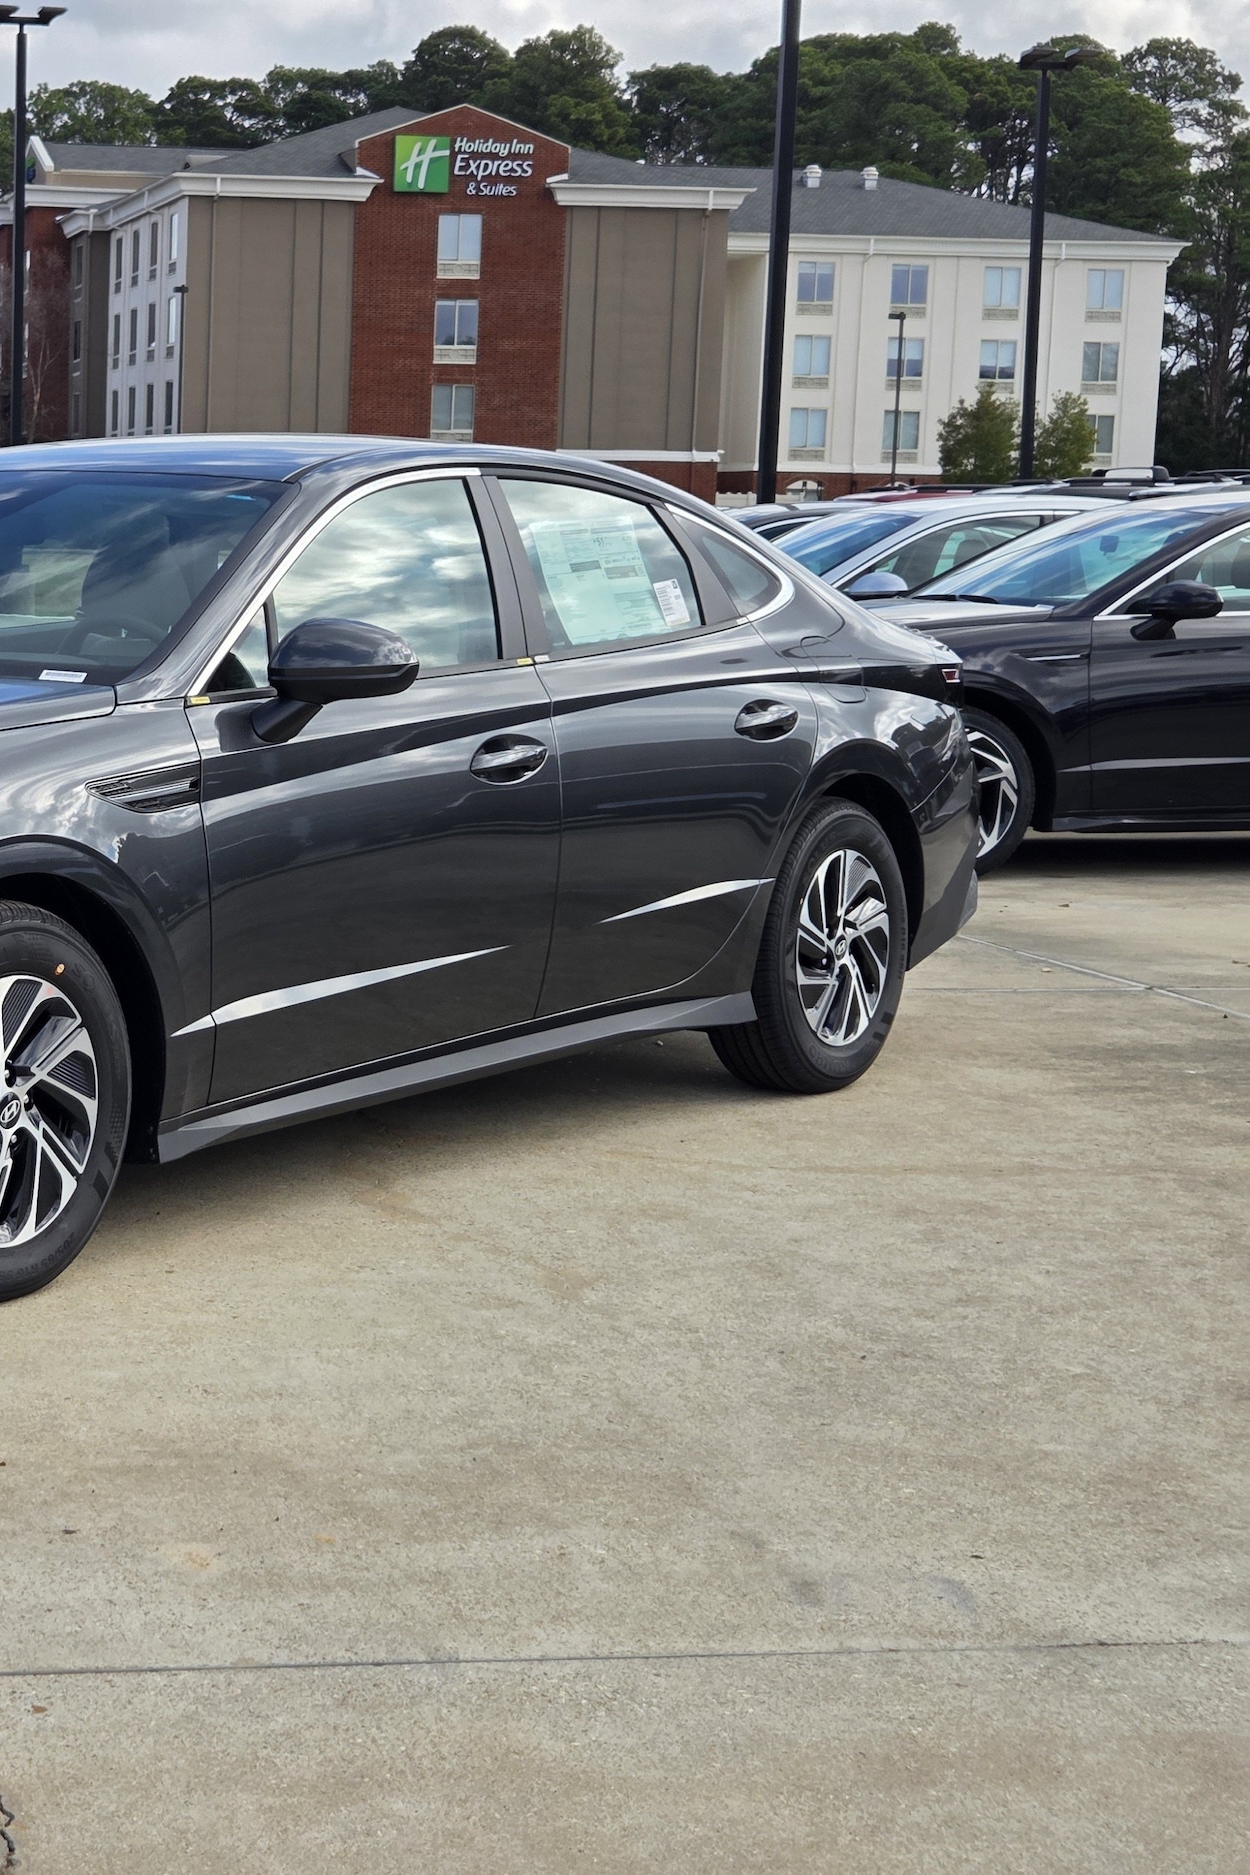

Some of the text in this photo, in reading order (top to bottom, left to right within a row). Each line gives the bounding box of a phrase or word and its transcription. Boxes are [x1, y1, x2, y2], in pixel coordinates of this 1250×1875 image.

[453, 136, 535, 157] Holiday Inn
[453, 154, 534, 181] Express
[466, 181, 517, 196] & Suites
